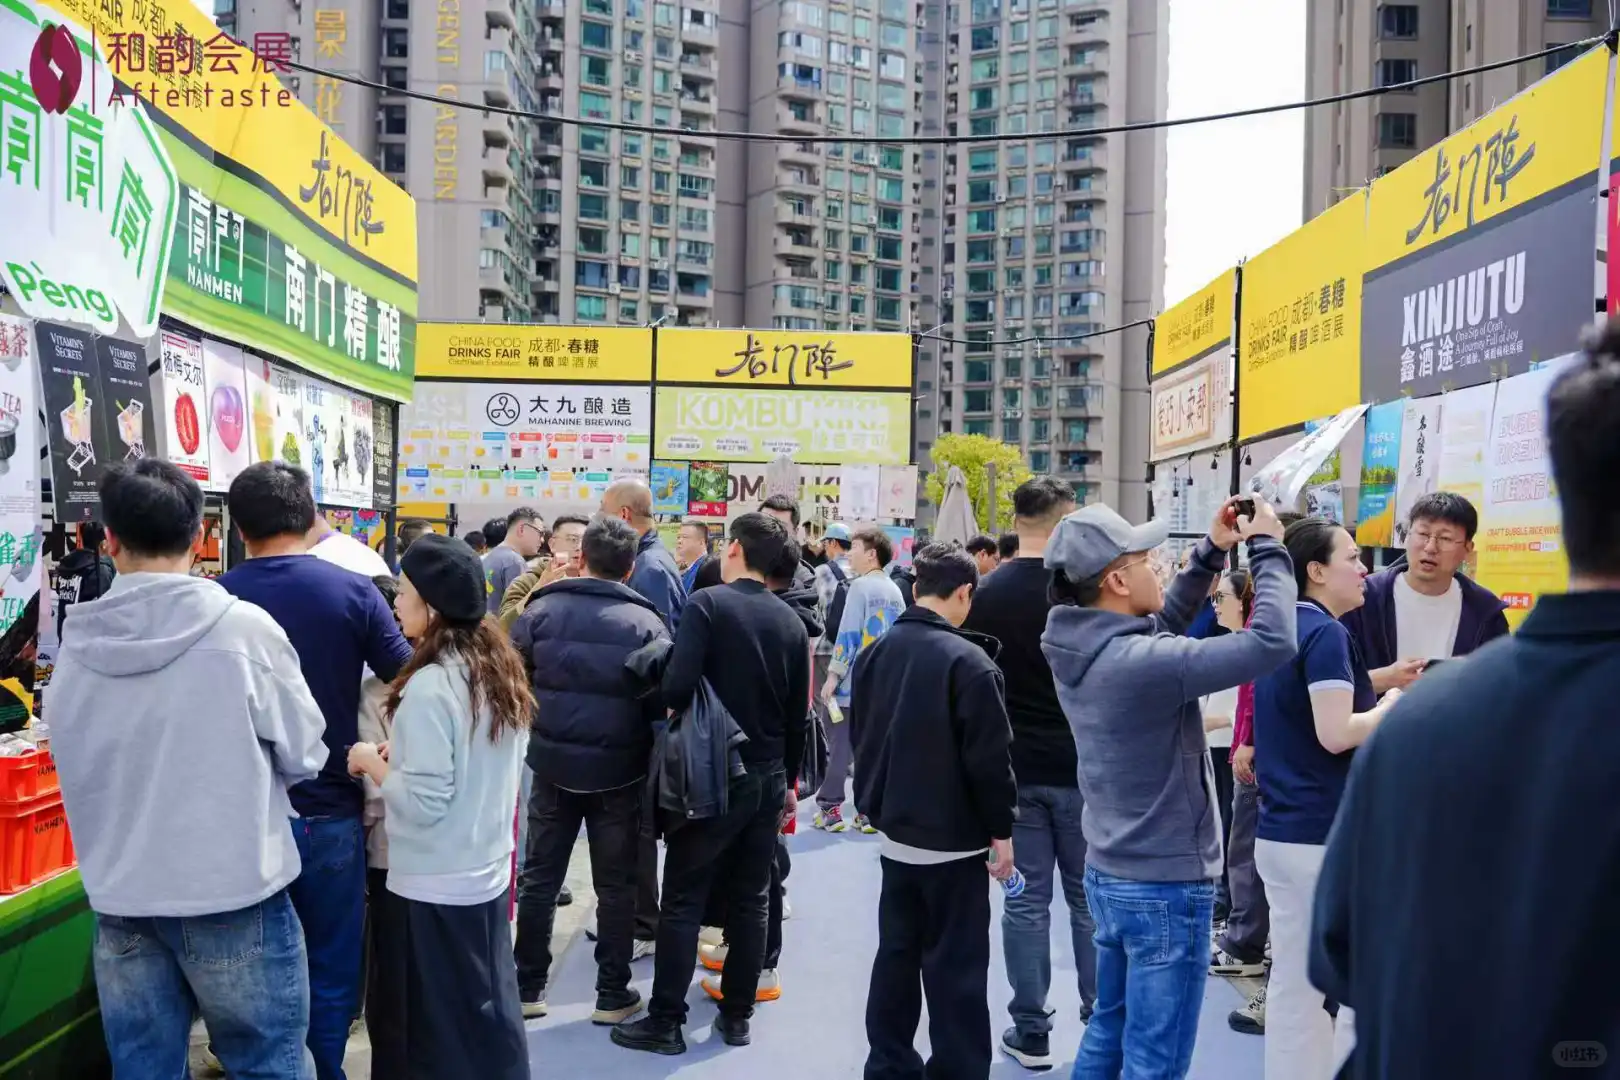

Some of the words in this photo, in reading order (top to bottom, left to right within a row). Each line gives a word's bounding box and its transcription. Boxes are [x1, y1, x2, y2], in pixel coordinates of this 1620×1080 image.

[94, 0, 123, 28] AIR
[433, 84, 458, 200] GARDEN
[188, 263, 243, 304] NANMEN
[284, 243, 402, 371] 南门精酿
[1402, 250, 1527, 347] XINJIUTU
[50, 331, 84, 350] VITAMIN'S
[449, 336, 484, 348] CHINA
[487, 337, 521, 348] FOOD
[528, 337, 600, 354] 成都·春糖
[1272, 325, 1288, 347] FAIR
[55, 345, 83, 361] SECRETS
[109, 344, 137, 362] VITAMIN'S
[449, 347, 491, 358] DRINKS
[495, 348, 521, 359] FAIR
[528, 355, 600, 368] 精酿啤酒展
[1401, 334, 1454, 383] 鑫酒途
[113, 357, 136, 372] SECRETS
[3, 391, 22, 415] TEA
[529, 395, 632, 416] 大九酿造
[677, 392, 806, 431] KOMBU
[529, 417, 583, 428] MAHANINE
[584, 418, 632, 428] BREWING
